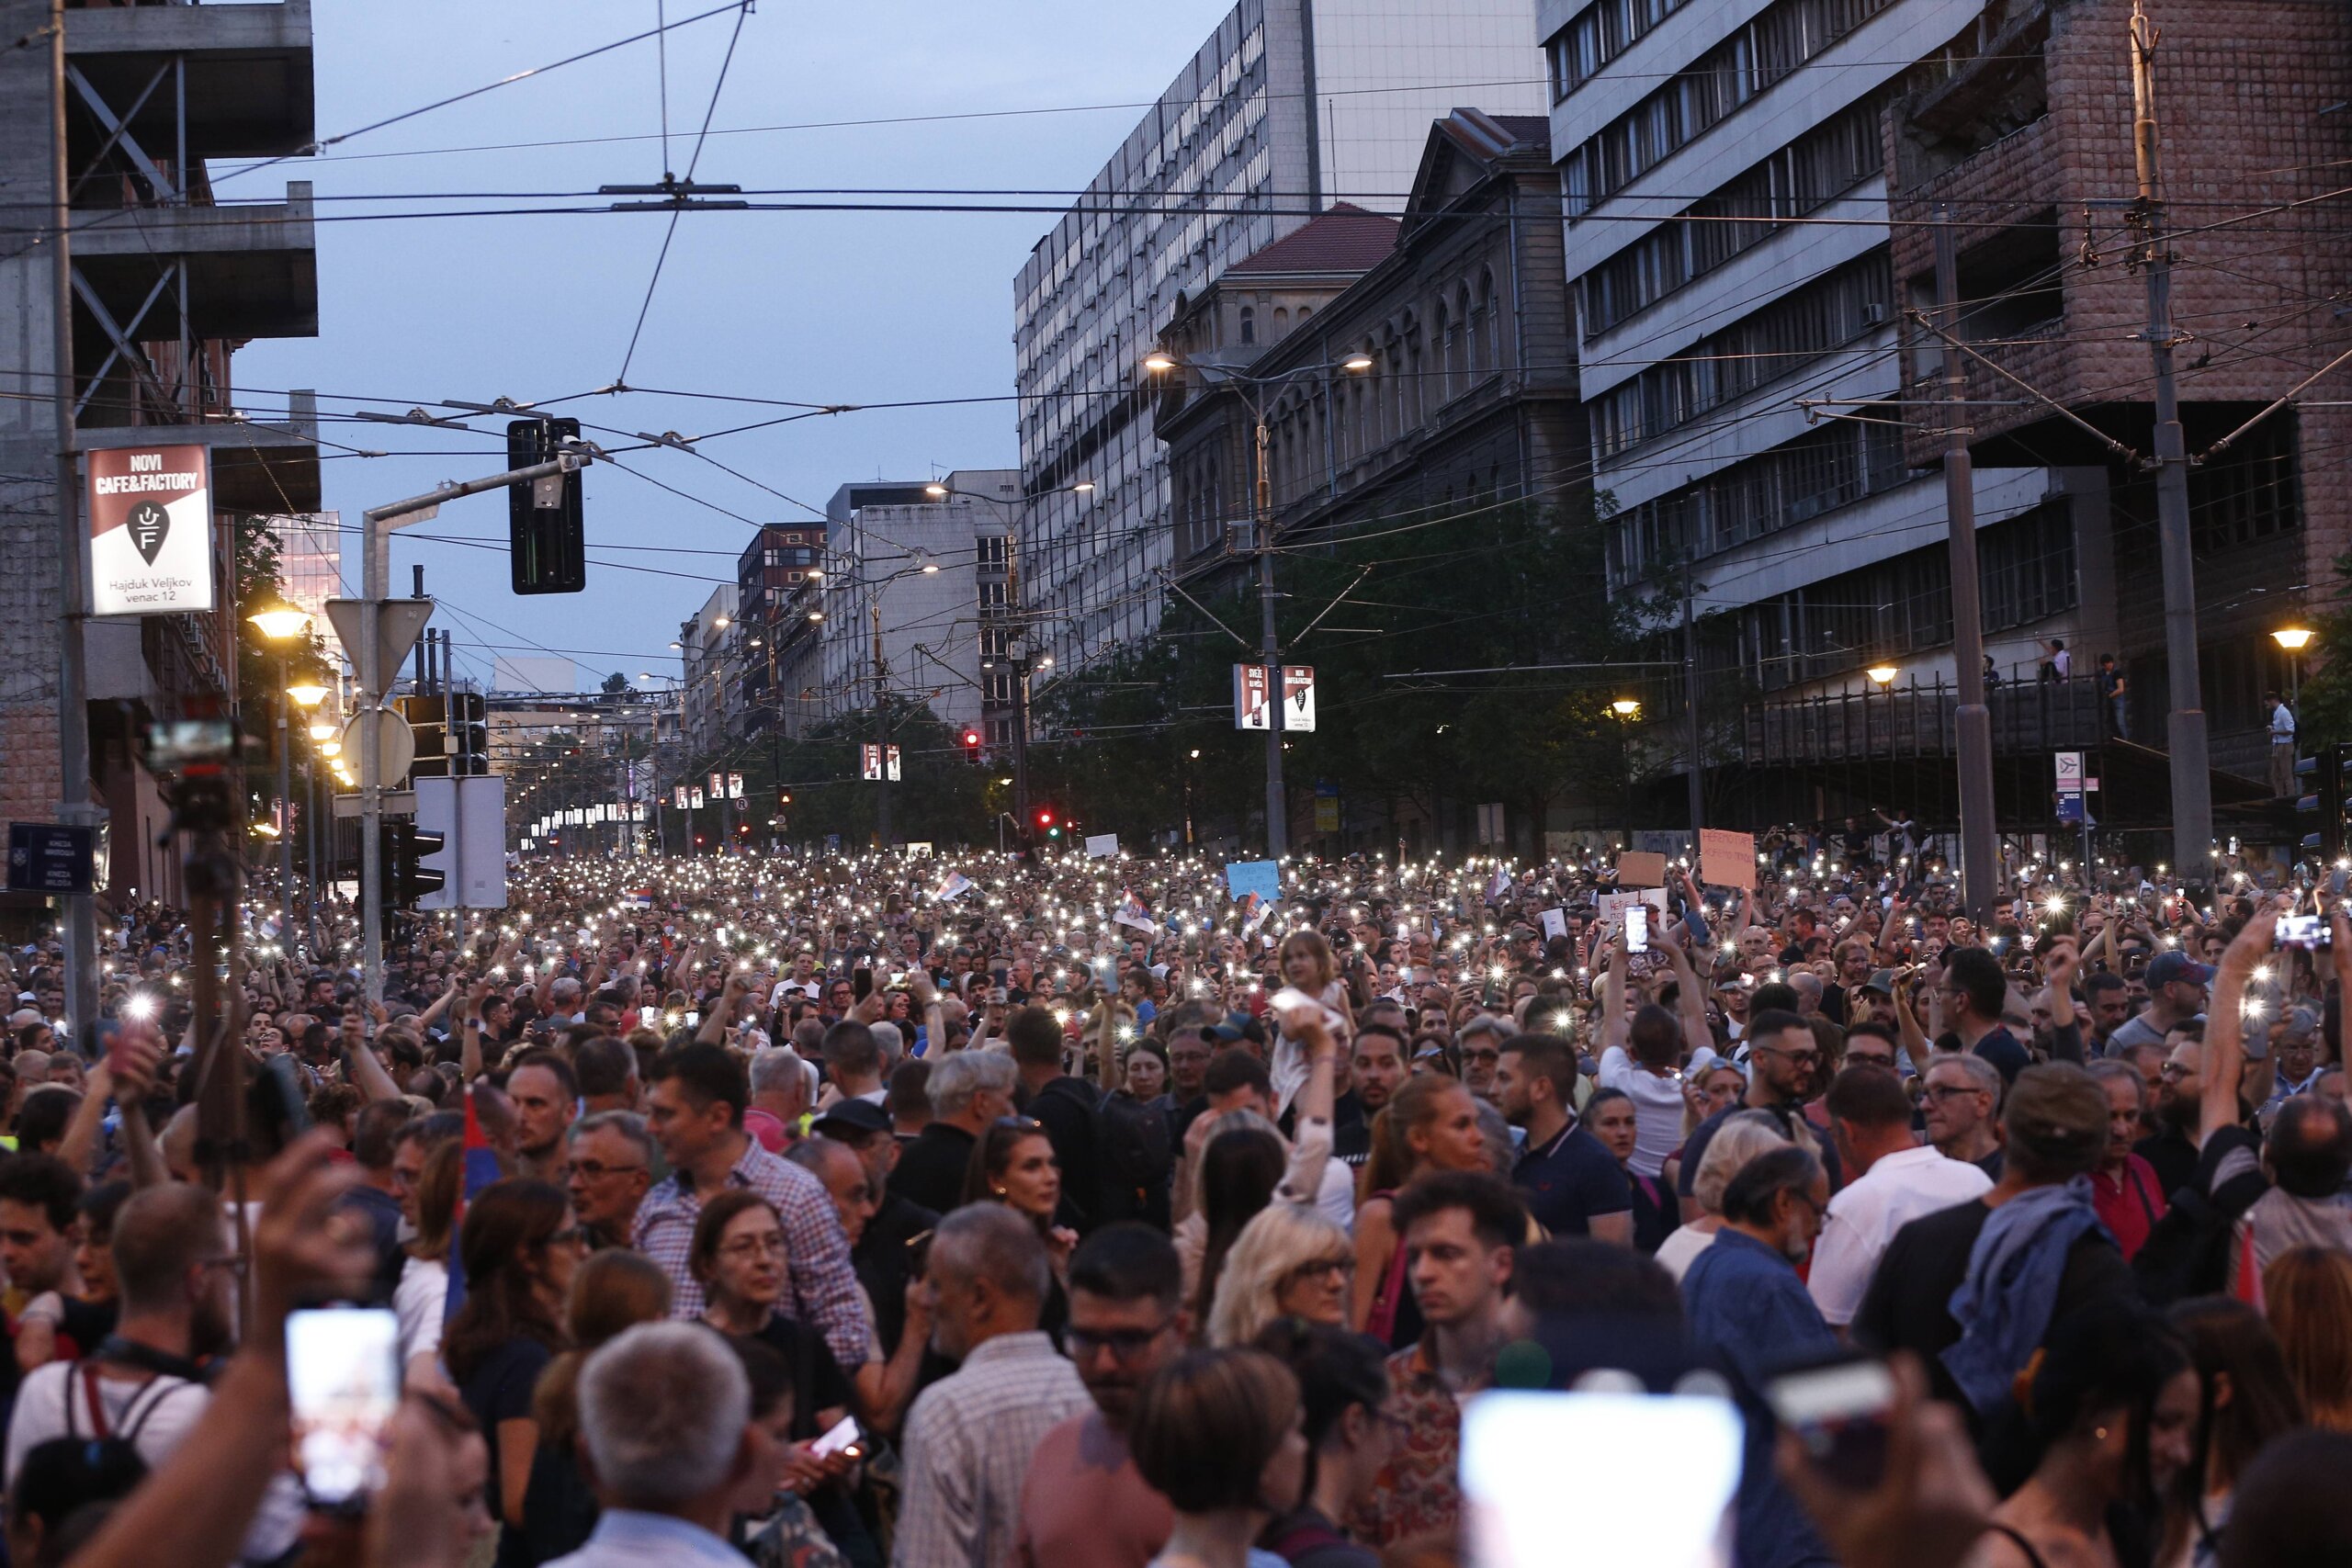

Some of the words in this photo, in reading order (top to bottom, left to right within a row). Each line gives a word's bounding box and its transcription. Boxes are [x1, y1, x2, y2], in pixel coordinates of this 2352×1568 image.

[130, 454, 162, 472] NOVI
[96, 472, 198, 495] CAFE&FACTORY
[109, 578, 149, 592] Hajduk
[152, 577, 192, 591] Veljkov
[126, 592, 158, 603] venac
[162, 591, 176, 601] 12
